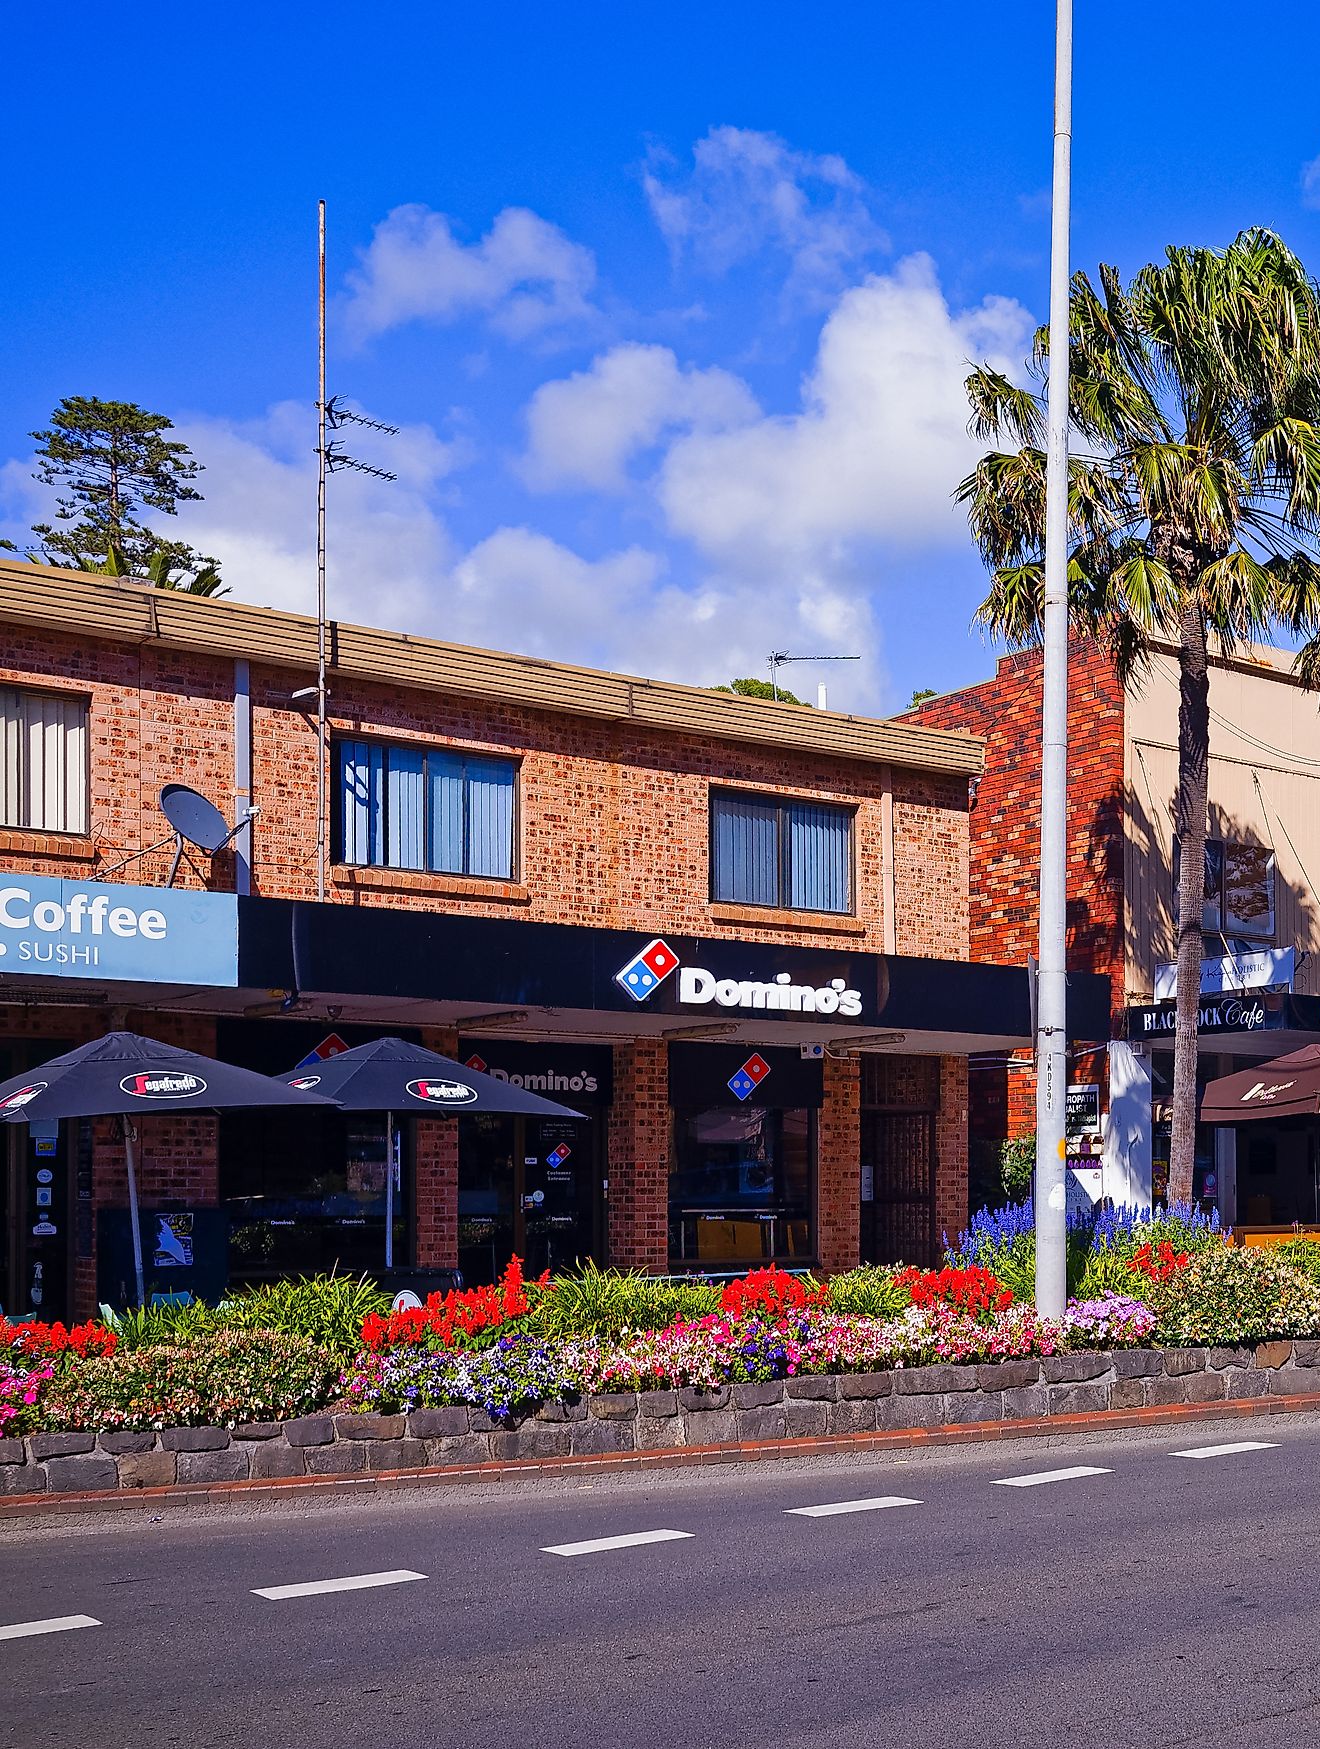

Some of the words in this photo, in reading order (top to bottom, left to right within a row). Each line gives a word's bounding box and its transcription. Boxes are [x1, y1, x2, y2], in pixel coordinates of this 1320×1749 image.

[0, 887, 167, 940] Coffee
[18, 941, 99, 966] SUSHI
[676, 966, 863, 1017] Domino's
[1143, 1010, 1178, 1031] BLAC
[1196, 1006, 1222, 1027] OCK
[1221, 998, 1264, 1030] Cafe
[132, 1074, 197, 1095] Segafredo
[417, 1082, 470, 1098] Segafredo
[1065, 1104, 1088, 1113] ALIST
[1066, 1094, 1096, 1104] ROPATH
